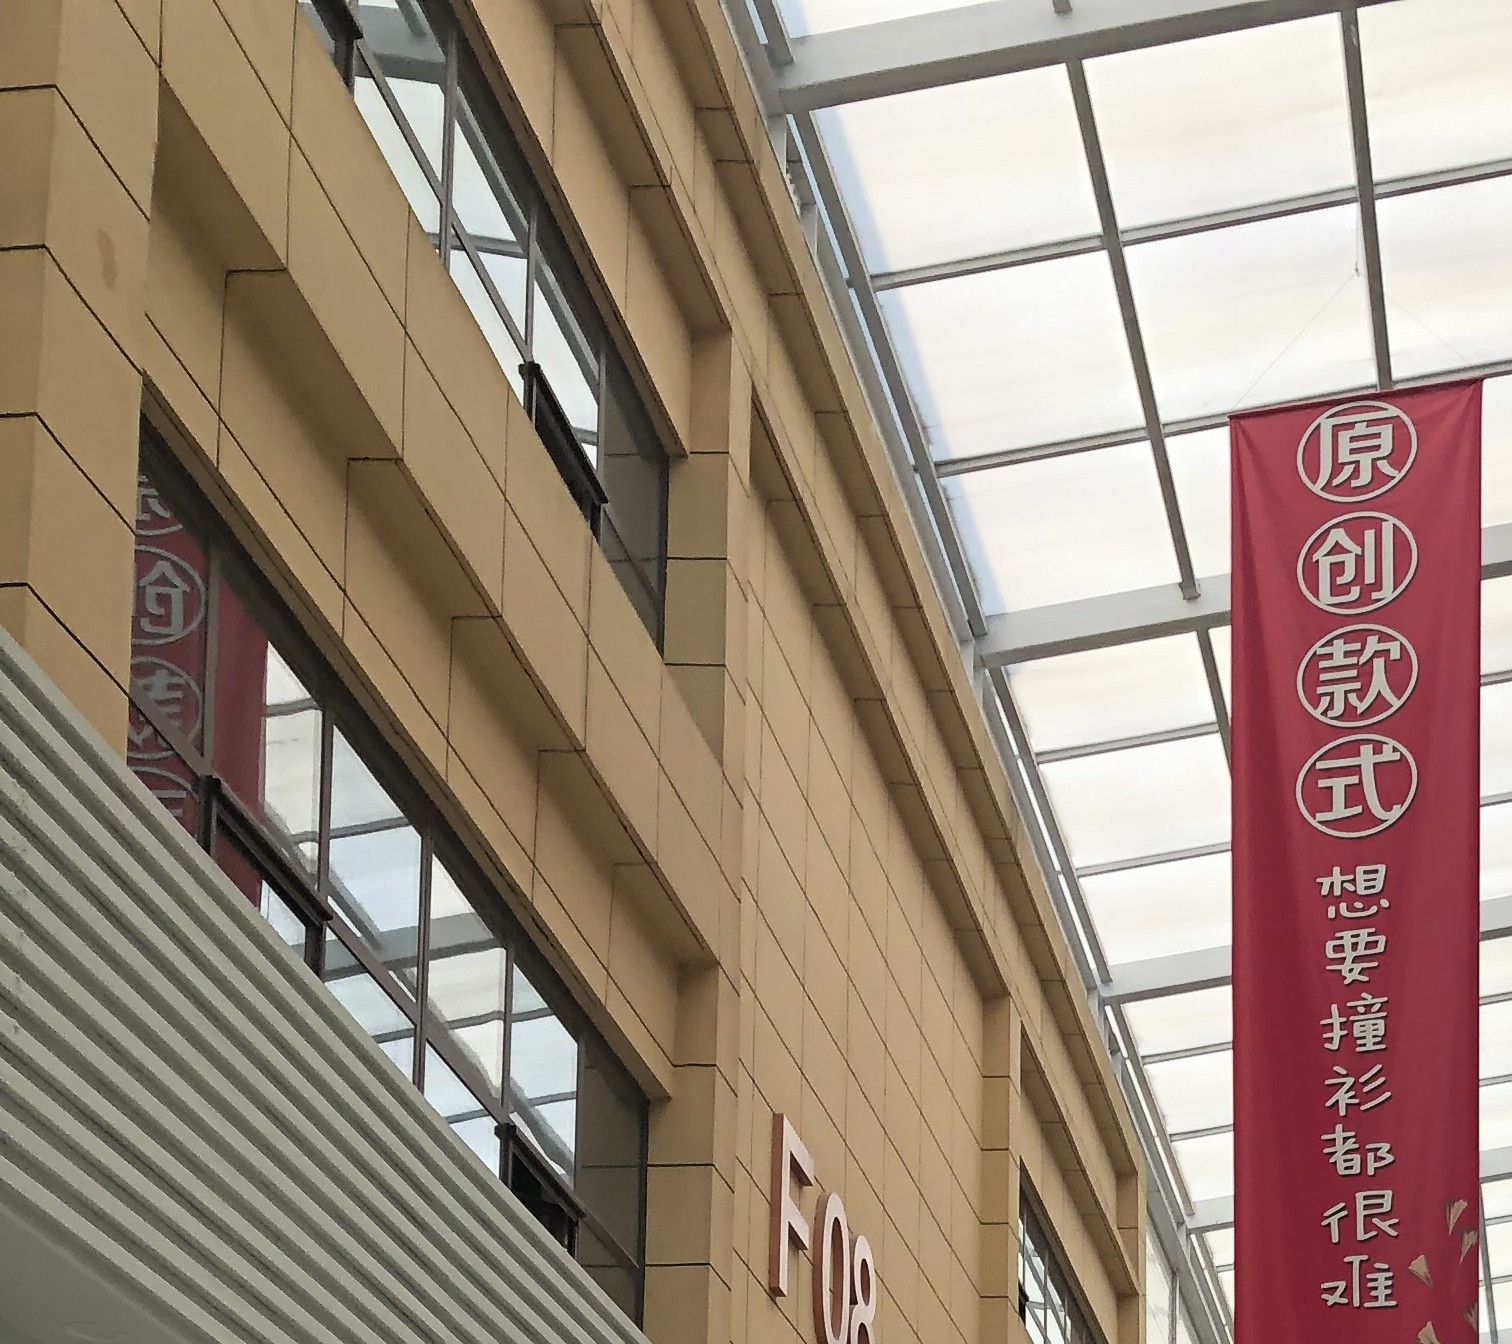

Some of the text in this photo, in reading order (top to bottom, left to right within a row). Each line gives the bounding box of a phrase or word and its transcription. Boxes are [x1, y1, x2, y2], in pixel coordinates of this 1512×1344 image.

[1299, 403, 1415, 836] 原创款式
[1316, 864, 1399, 1308] 想要撞衫都很难
